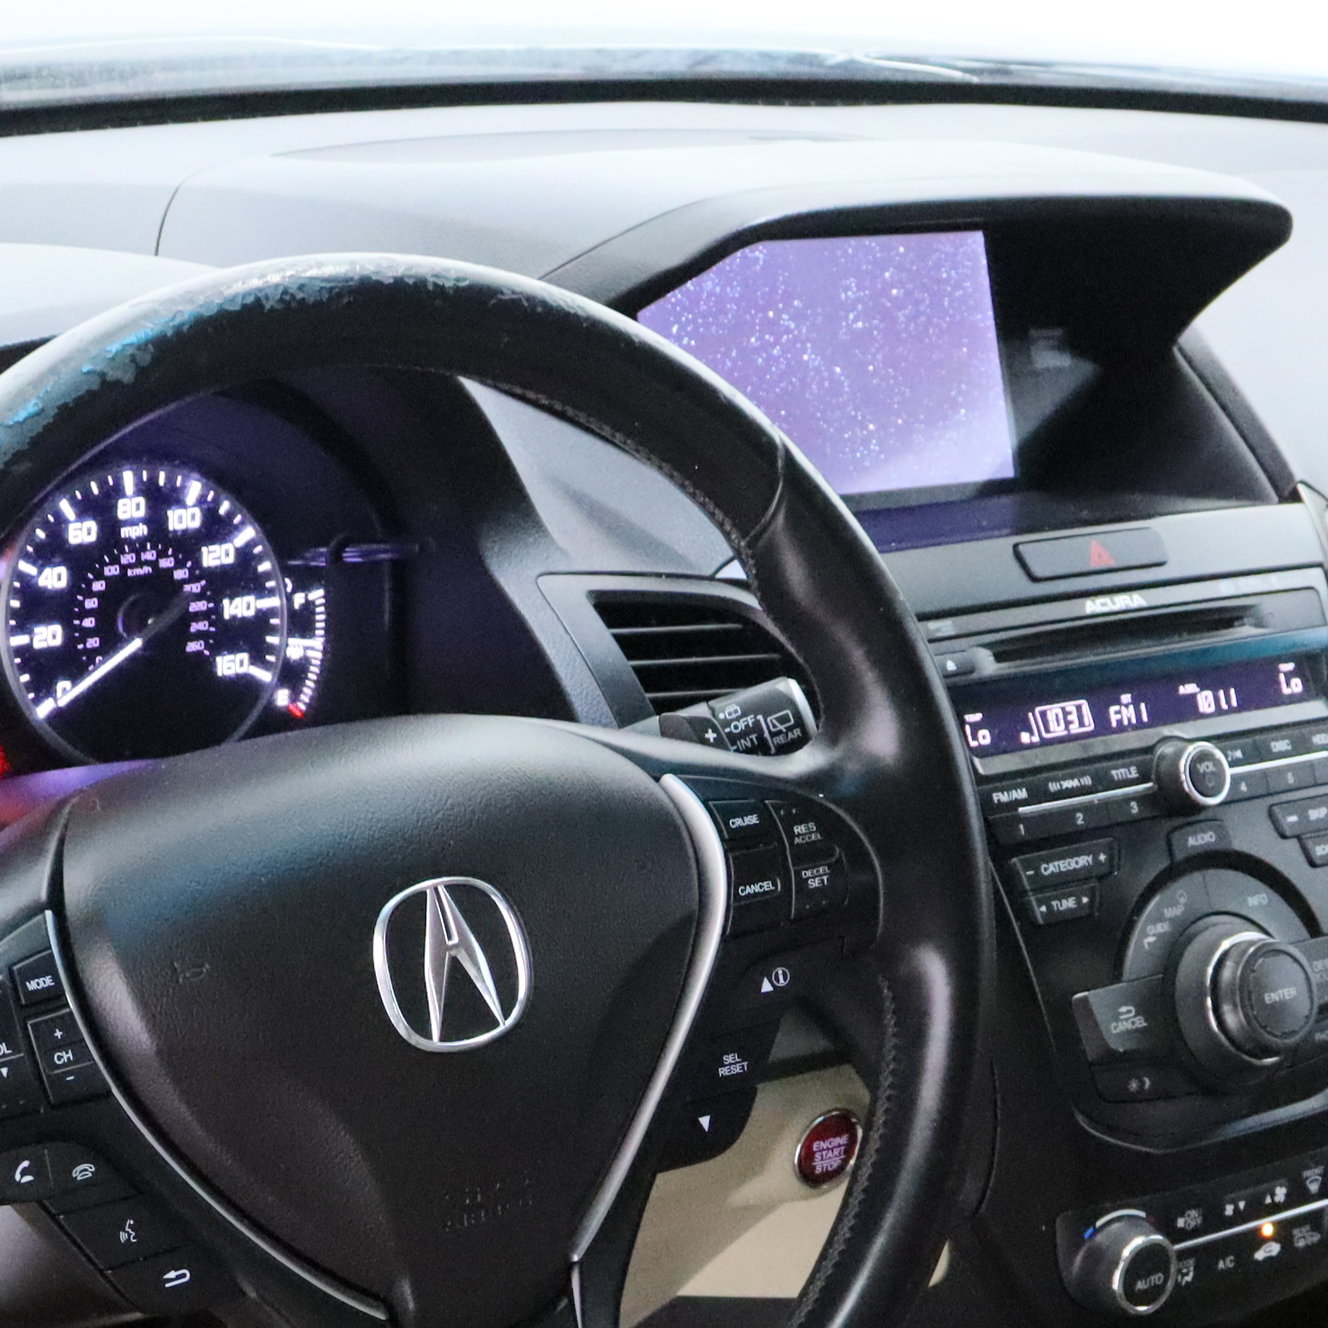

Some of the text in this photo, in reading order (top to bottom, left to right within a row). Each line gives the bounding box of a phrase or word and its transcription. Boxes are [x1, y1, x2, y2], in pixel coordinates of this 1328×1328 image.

[117, 497, 146, 520] 80
[167, 507, 201, 530] 100
[67, 521, 97, 545] 60
[120, 524, 148, 541] mph
[120, 553, 136, 564] 120
[141, 550, 156, 561] 140
[201, 543, 235, 567] 120
[38, 566, 67, 589] 40
[104, 565, 119, 576] 100
[127, 566, 152, 577] km/h
[222, 596, 256, 619] 140
[294, 592, 306, 609] F
[1085, 593, 1147, 614] ACURA
[32, 625, 62, 649] 20
[216, 653, 250, 678] 160
[1279, 672, 1304, 695] Lo
[731, 715, 756, 733] OFF
[737, 733, 759, 751] INT
[772, 728, 802, 746] REAR
[965, 724, 991, 747] Lo
[1110, 766, 1139, 781] TITLE
[1197, 761, 1216, 773] VOL
[1240, 781, 1248, 793] 4
[992, 787, 1028, 804] FM/AM
[1130, 801, 1139, 813] 3
[729, 814, 760, 829] CRUISE
[1076, 812, 1084, 825] 2
[793, 822, 817, 836] RES
[1019, 824, 1025, 836] 1
[794, 832, 823, 845] ACCEL
[1188, 831, 1215, 847] AUDIO
[801, 865, 831, 878] DECEL
[1040, 854, 1093, 876] CATEGORY
[738, 880, 775, 896] CANCEL
[807, 875, 830, 889] SET
[1051, 896, 1078, 912] TUNE
[25, 975, 56, 992] MODE
[1264, 987, 1297, 1005] ENTER
[1111, 1016, 1148, 1034] CANCEL
[53, 1049, 74, 1065] CH
[722, 1053, 742, 1066] SEL
[718, 1061, 749, 1077] RESET
[813, 1134, 849, 1152] ENGINE
[814, 1146, 845, 1162] START
[815, 1160, 842, 1175] STOP
[1217, 1255, 1235, 1271] A/C
[1135, 1273, 1164, 1293] AUTO
